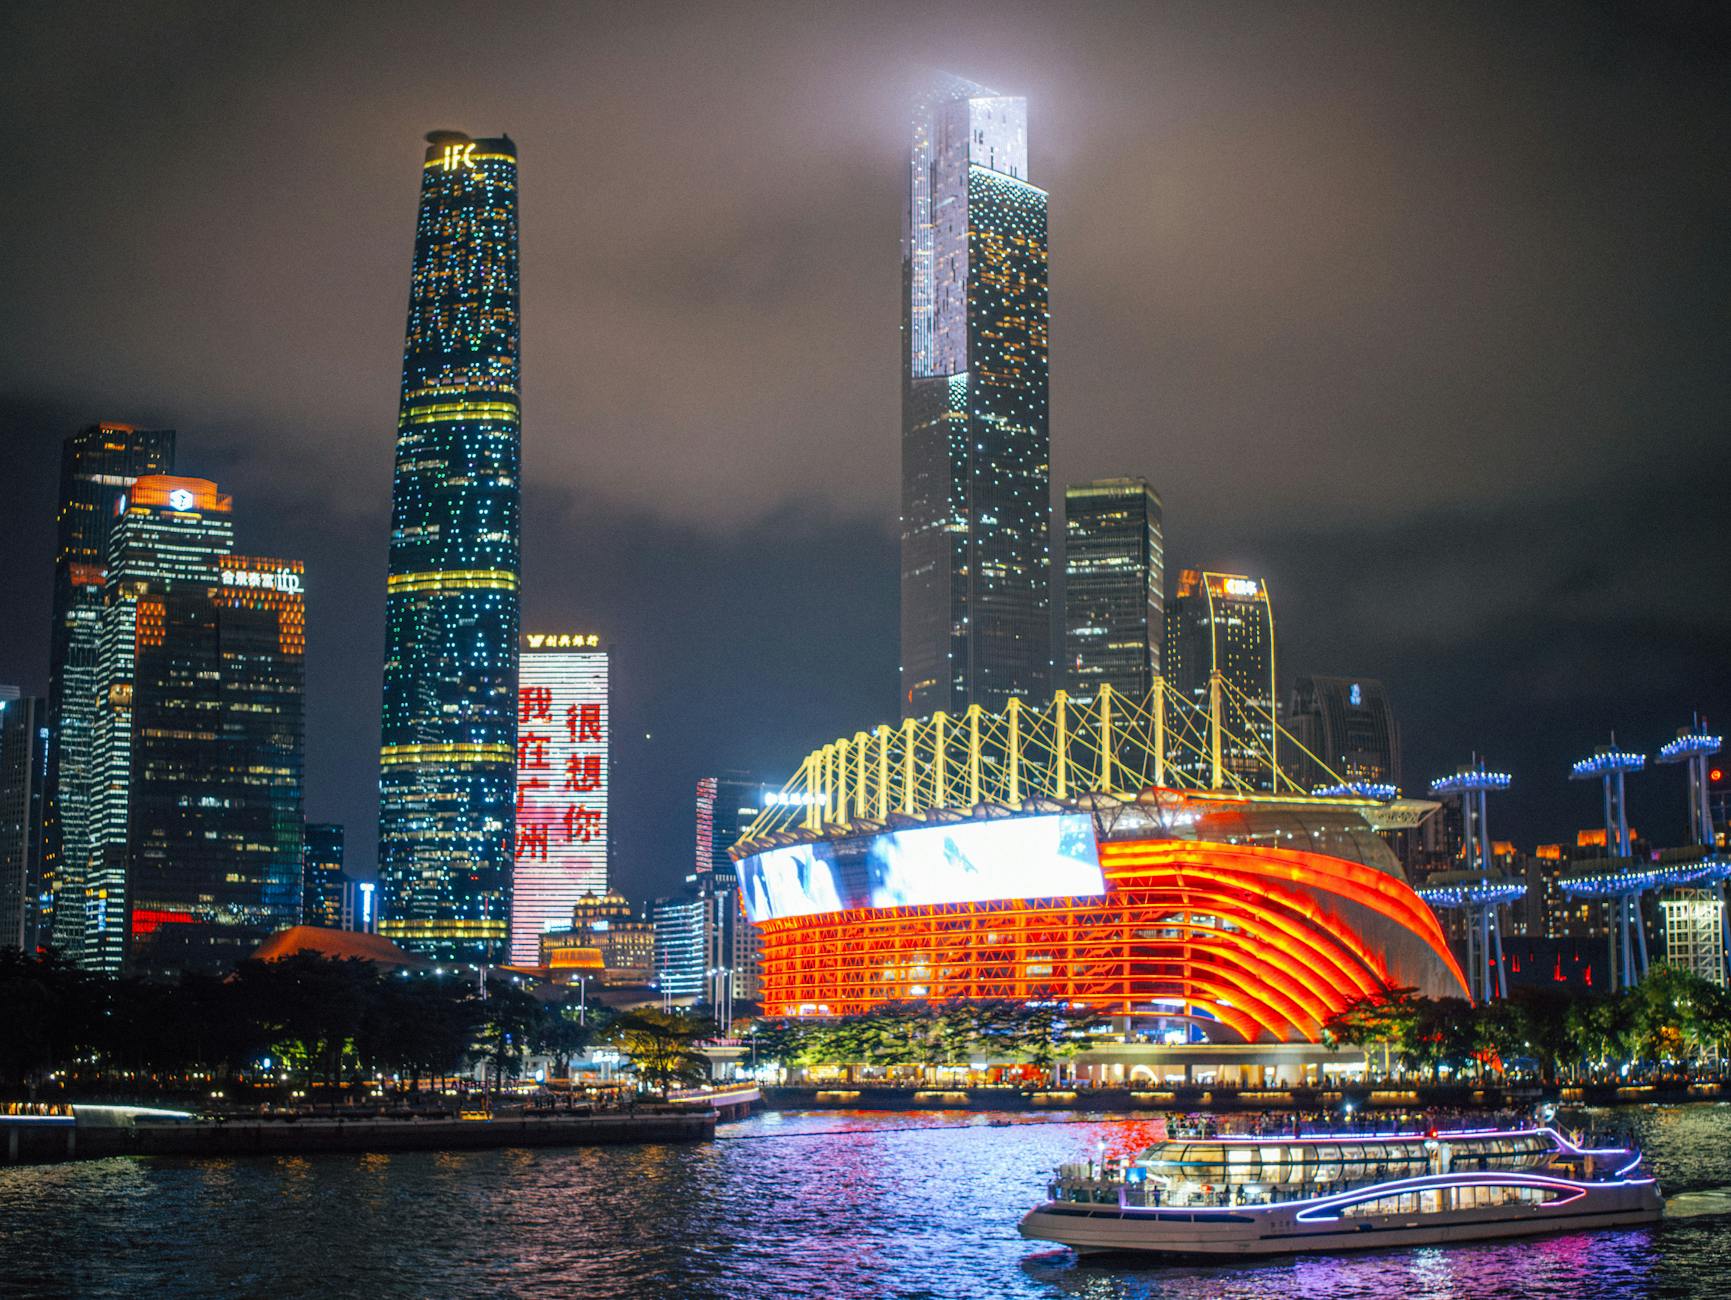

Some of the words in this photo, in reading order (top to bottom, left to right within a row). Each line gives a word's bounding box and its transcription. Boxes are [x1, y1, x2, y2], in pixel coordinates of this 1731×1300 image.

[443, 143, 476, 171] IFC
[515, 687, 552, 862] 我在广州
[563, 703, 602, 843] 很想你
